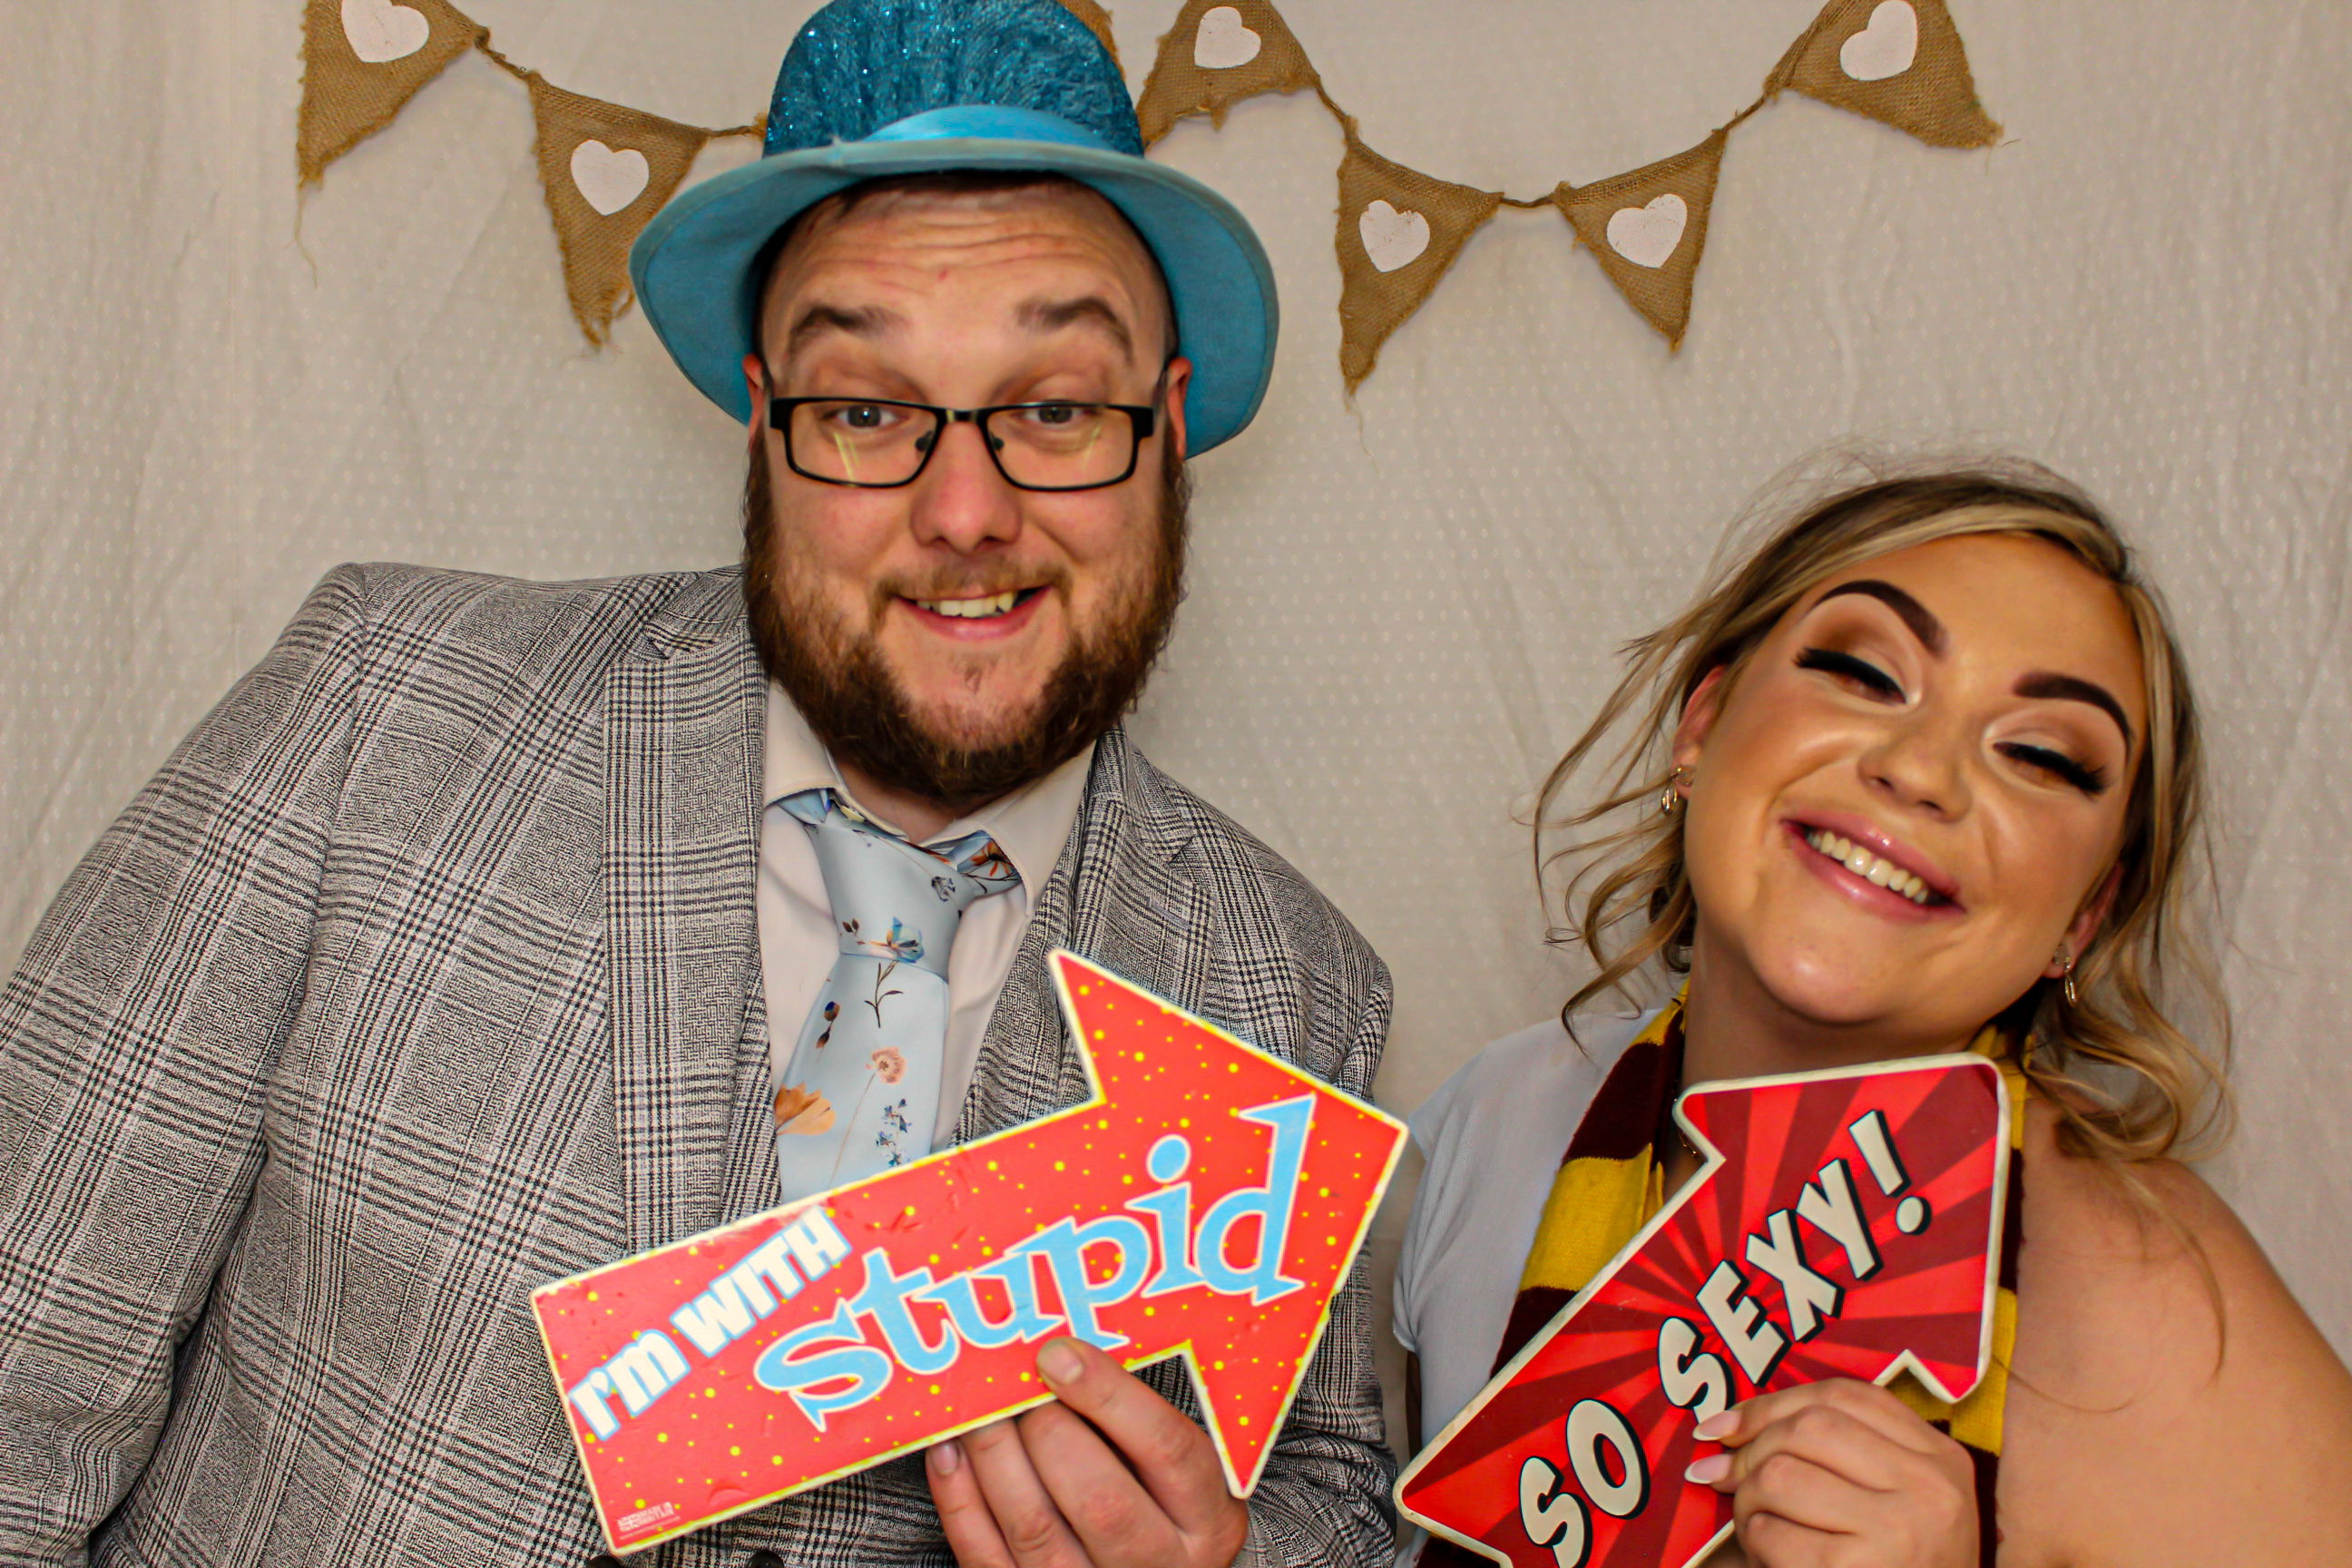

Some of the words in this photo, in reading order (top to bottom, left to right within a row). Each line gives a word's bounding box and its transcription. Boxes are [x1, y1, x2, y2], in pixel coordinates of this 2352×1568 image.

[669, 1204, 853, 1357] WITH
[1520, 1398, 1651, 1568] SO
[1658, 1109, 1931, 1426] SEXY!
